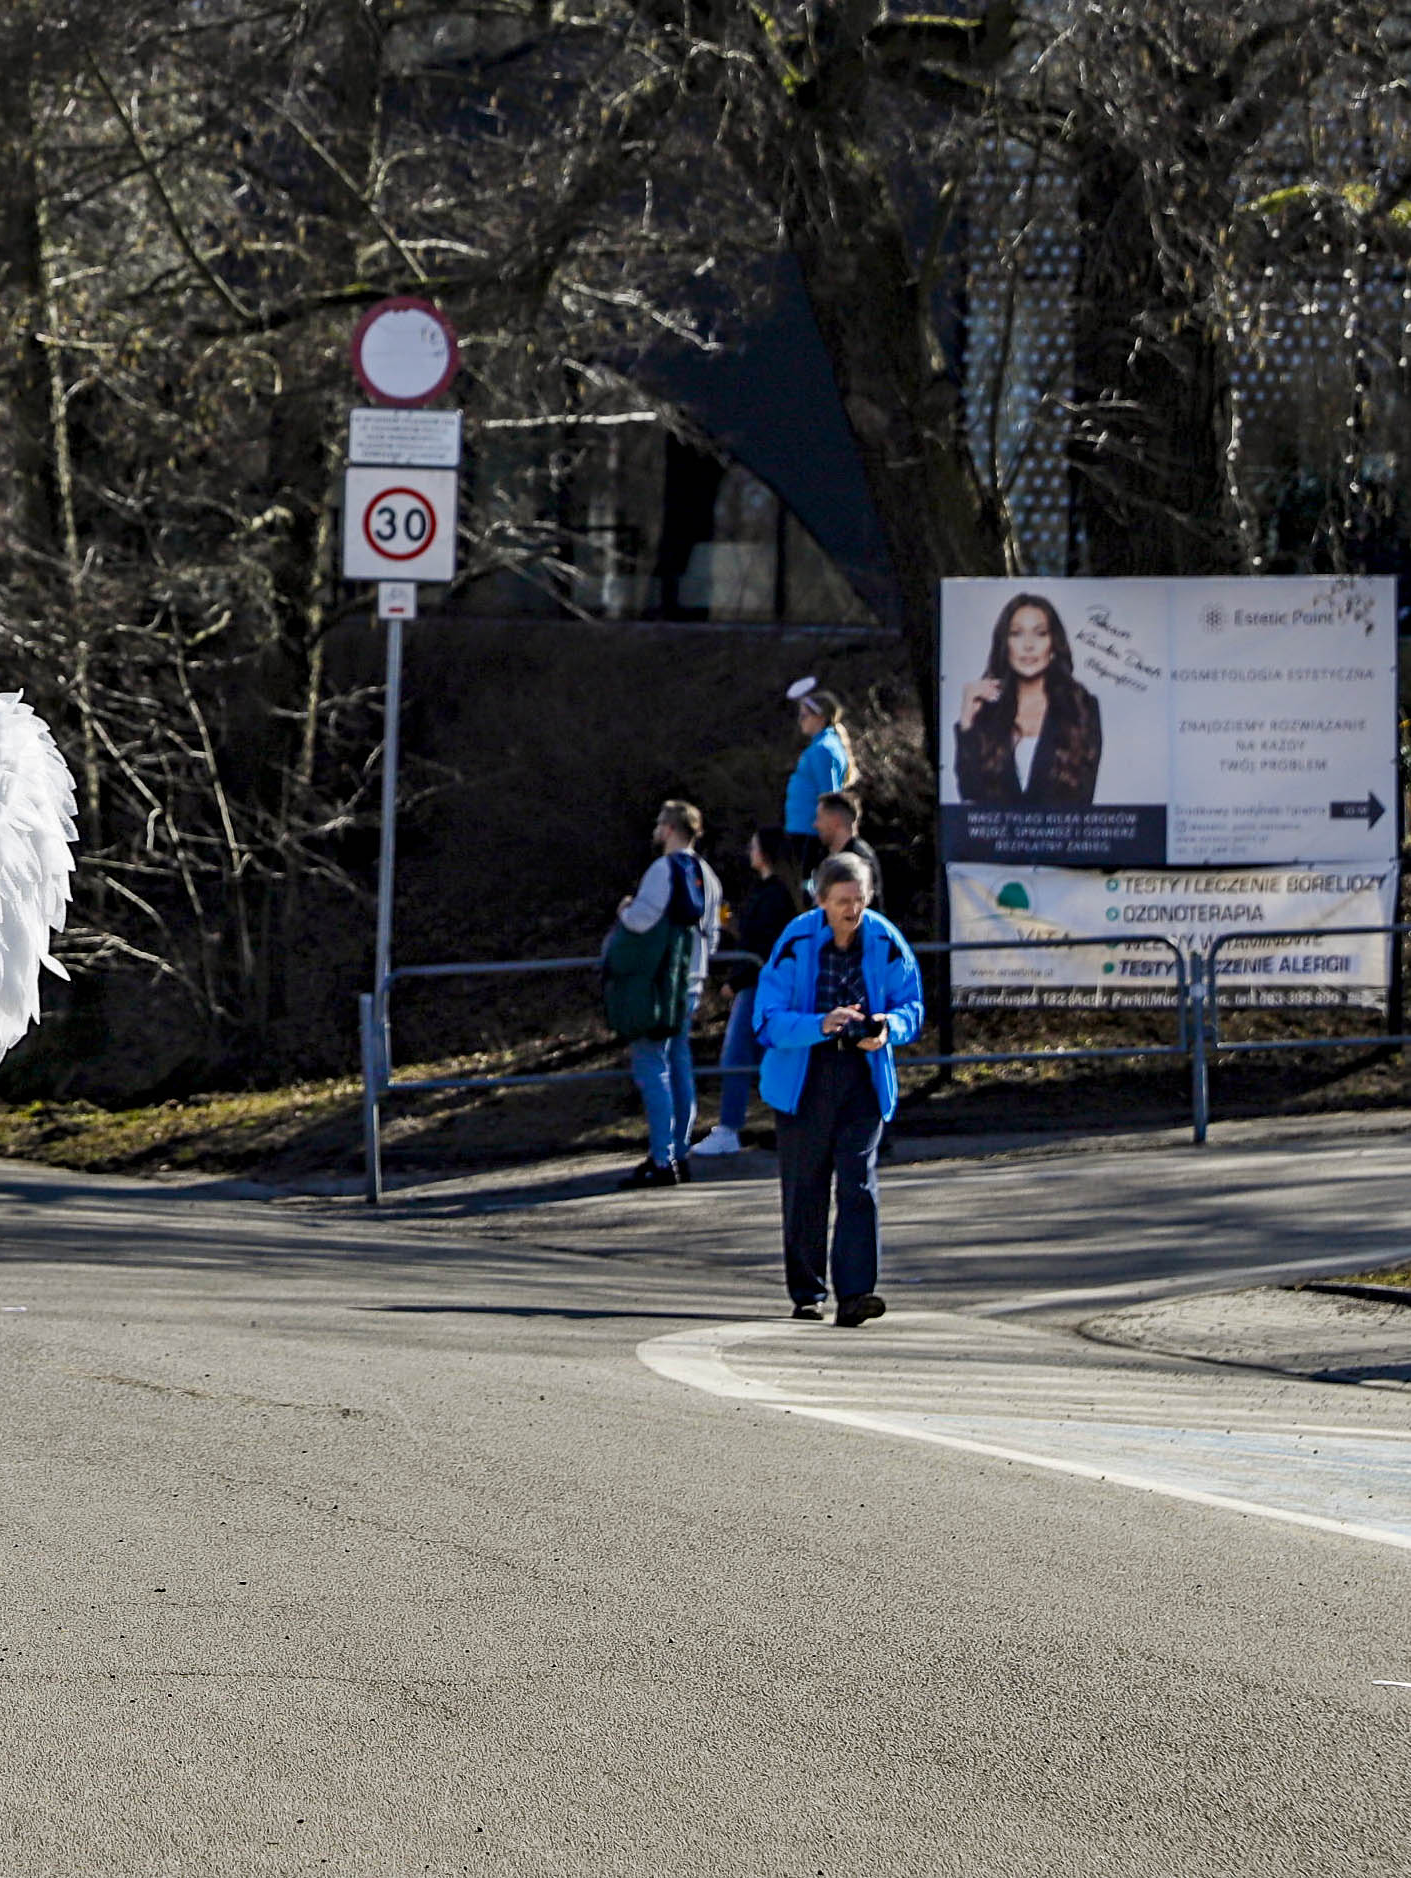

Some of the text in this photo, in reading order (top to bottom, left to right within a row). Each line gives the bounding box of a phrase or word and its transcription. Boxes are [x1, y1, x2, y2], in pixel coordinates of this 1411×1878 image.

[375, 507, 426, 541] 30
[1233, 607, 1335, 626] Estetic Point
[1260, 757, 1328, 773] PROBLEM
[1124, 877, 1181, 894] TESTY
[1193, 876, 1281, 894] LECZENIE
[1285, 873, 1387, 893] BORELIOZY
[1122, 903, 1264, 923] OZONOTERAPIA
[1119, 958, 1177, 976] TESTY
[1278, 954, 1352, 974] ALERGII
